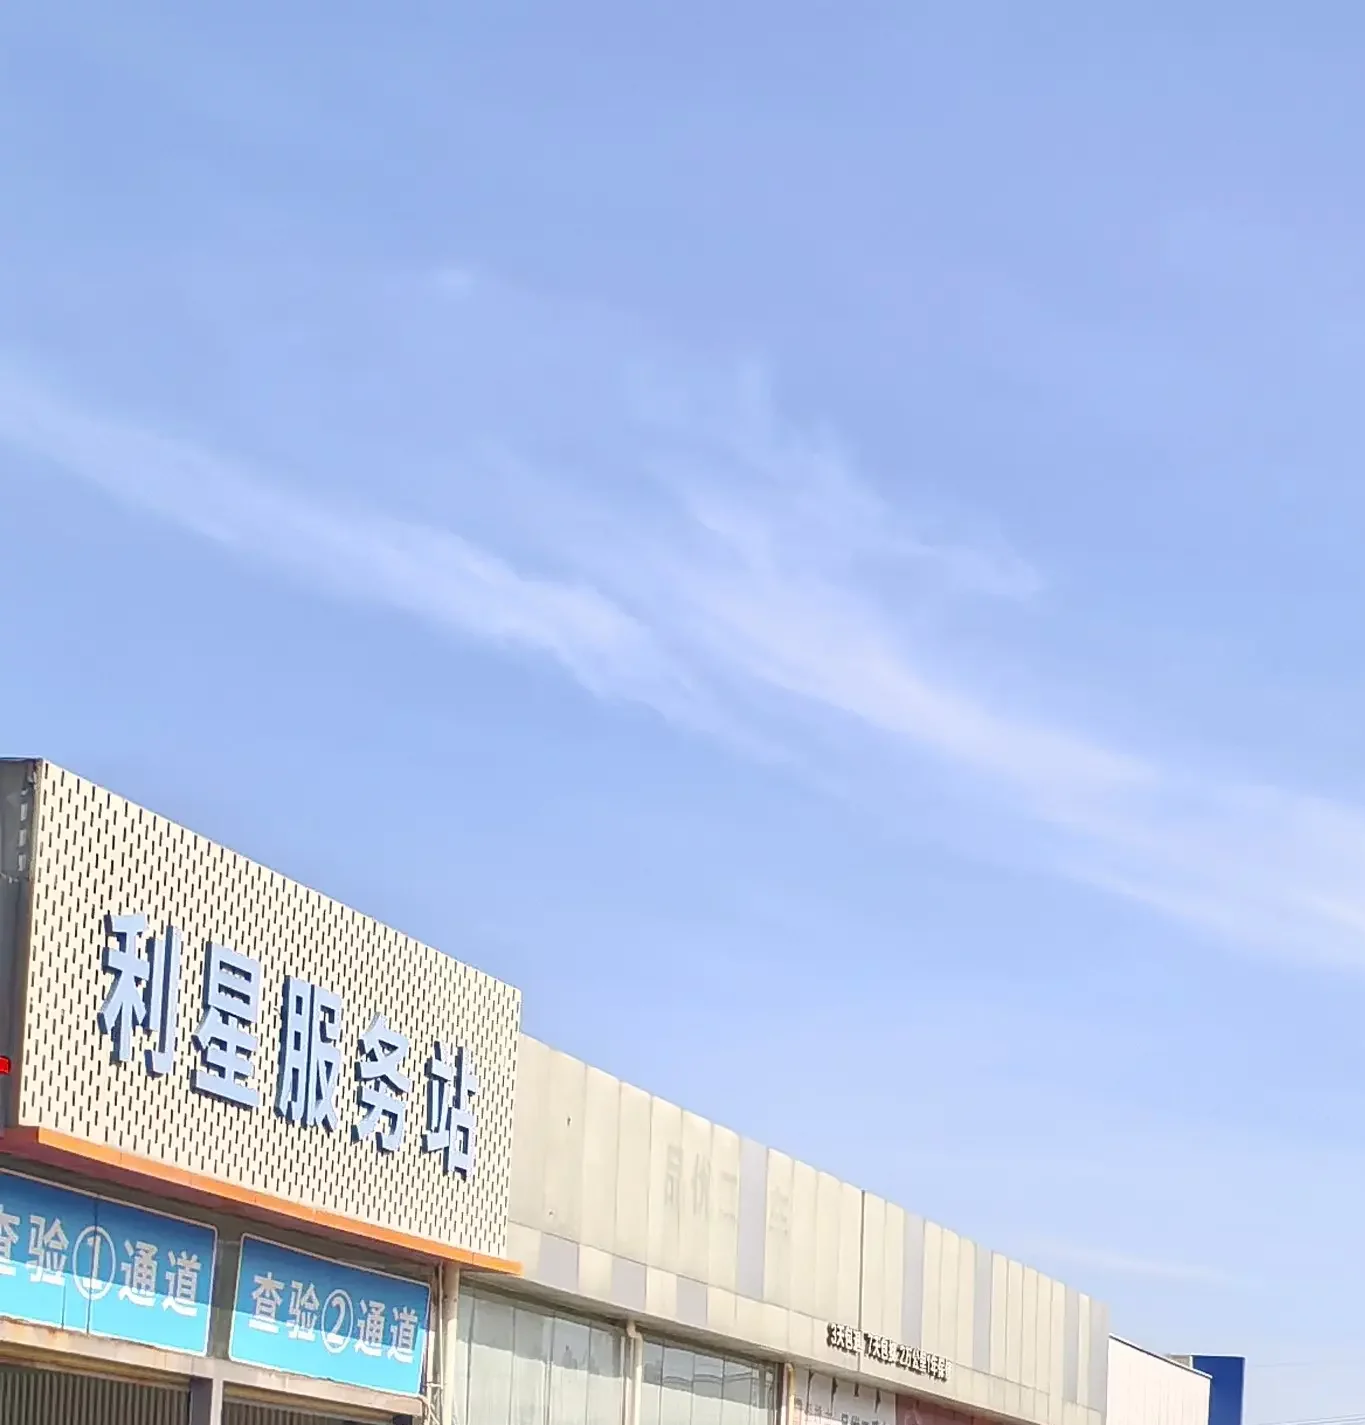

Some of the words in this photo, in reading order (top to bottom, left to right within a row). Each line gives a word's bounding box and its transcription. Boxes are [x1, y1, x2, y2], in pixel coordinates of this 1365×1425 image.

[96, 913, 478, 1179] 利星服务站
